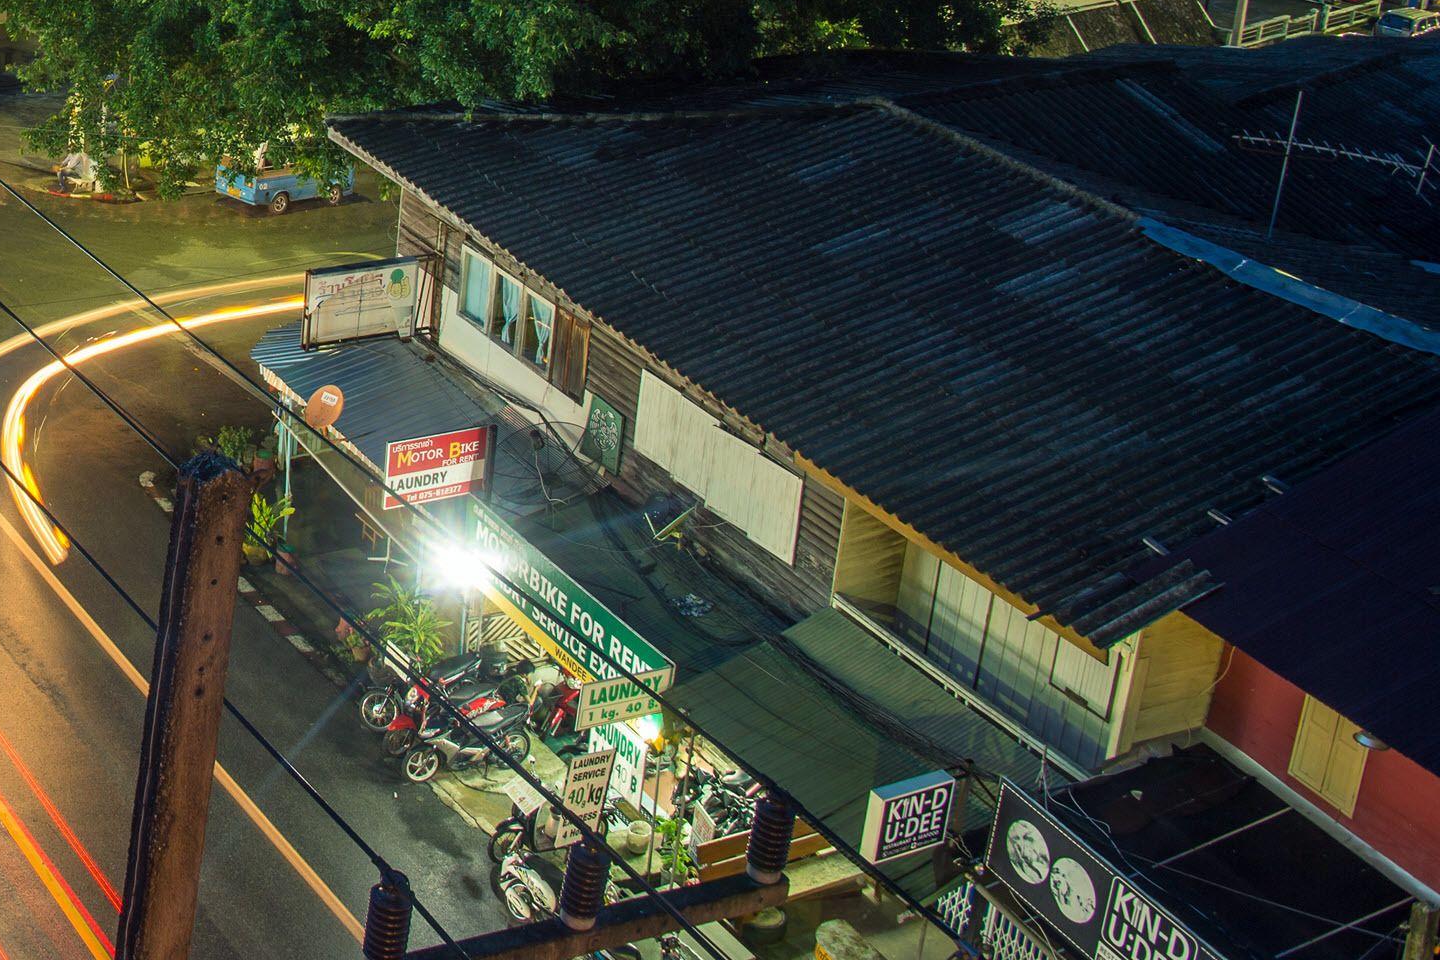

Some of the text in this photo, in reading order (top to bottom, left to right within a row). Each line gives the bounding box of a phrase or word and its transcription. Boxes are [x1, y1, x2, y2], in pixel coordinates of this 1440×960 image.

[397, 440, 480, 468] MOTOR BIKE
[442, 453, 480, 467] FOR RENT
[390, 470, 448, 492] LAUNDRY
[570, 602, 605, 651] FOR
[554, 646, 588, 682] WANDEE
[589, 674, 664, 706] LAUNDRY
[589, 711, 594, 722] 1
[625, 702, 642, 713] 40
[572, 768, 607, 782] SERVICE
[573, 754, 611, 770] LAUNDRY
[630, 775, 638, 793] B
[888, 787, 949, 823] KIN-D
[884, 809, 943, 844] U:DEE
[1113, 883, 1190, 960] KIN-D
